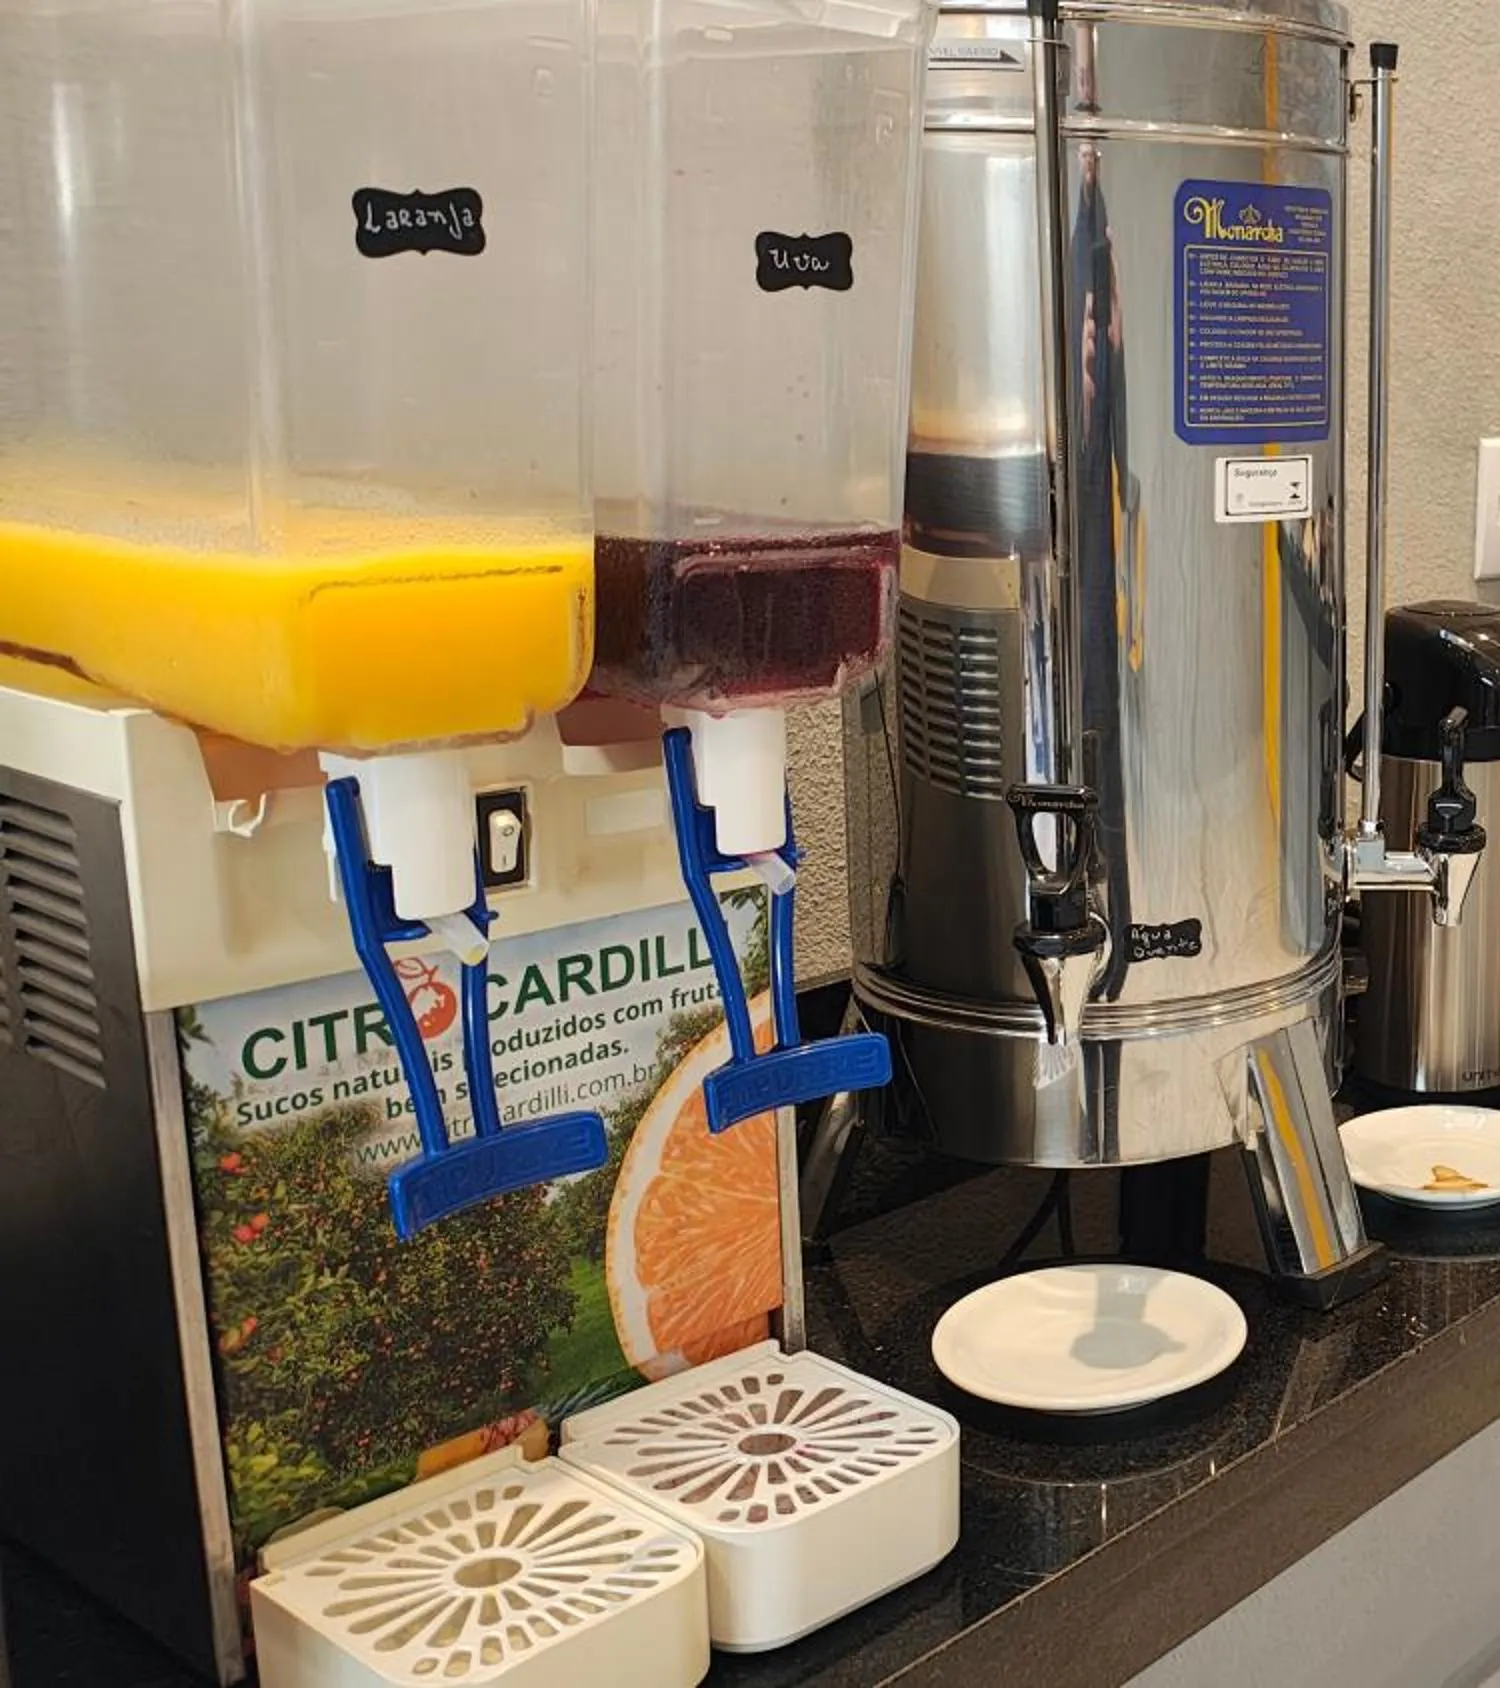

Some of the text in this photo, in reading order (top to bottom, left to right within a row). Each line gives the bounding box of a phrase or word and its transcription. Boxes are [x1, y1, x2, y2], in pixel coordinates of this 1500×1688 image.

[767, 247, 831, 271] Uva
[486, 927, 714, 1022] CARDILL
[236, 982, 722, 1127] Sucos natuis oduzidos com frut
[455, 1038, 630, 1101] secionadas.
